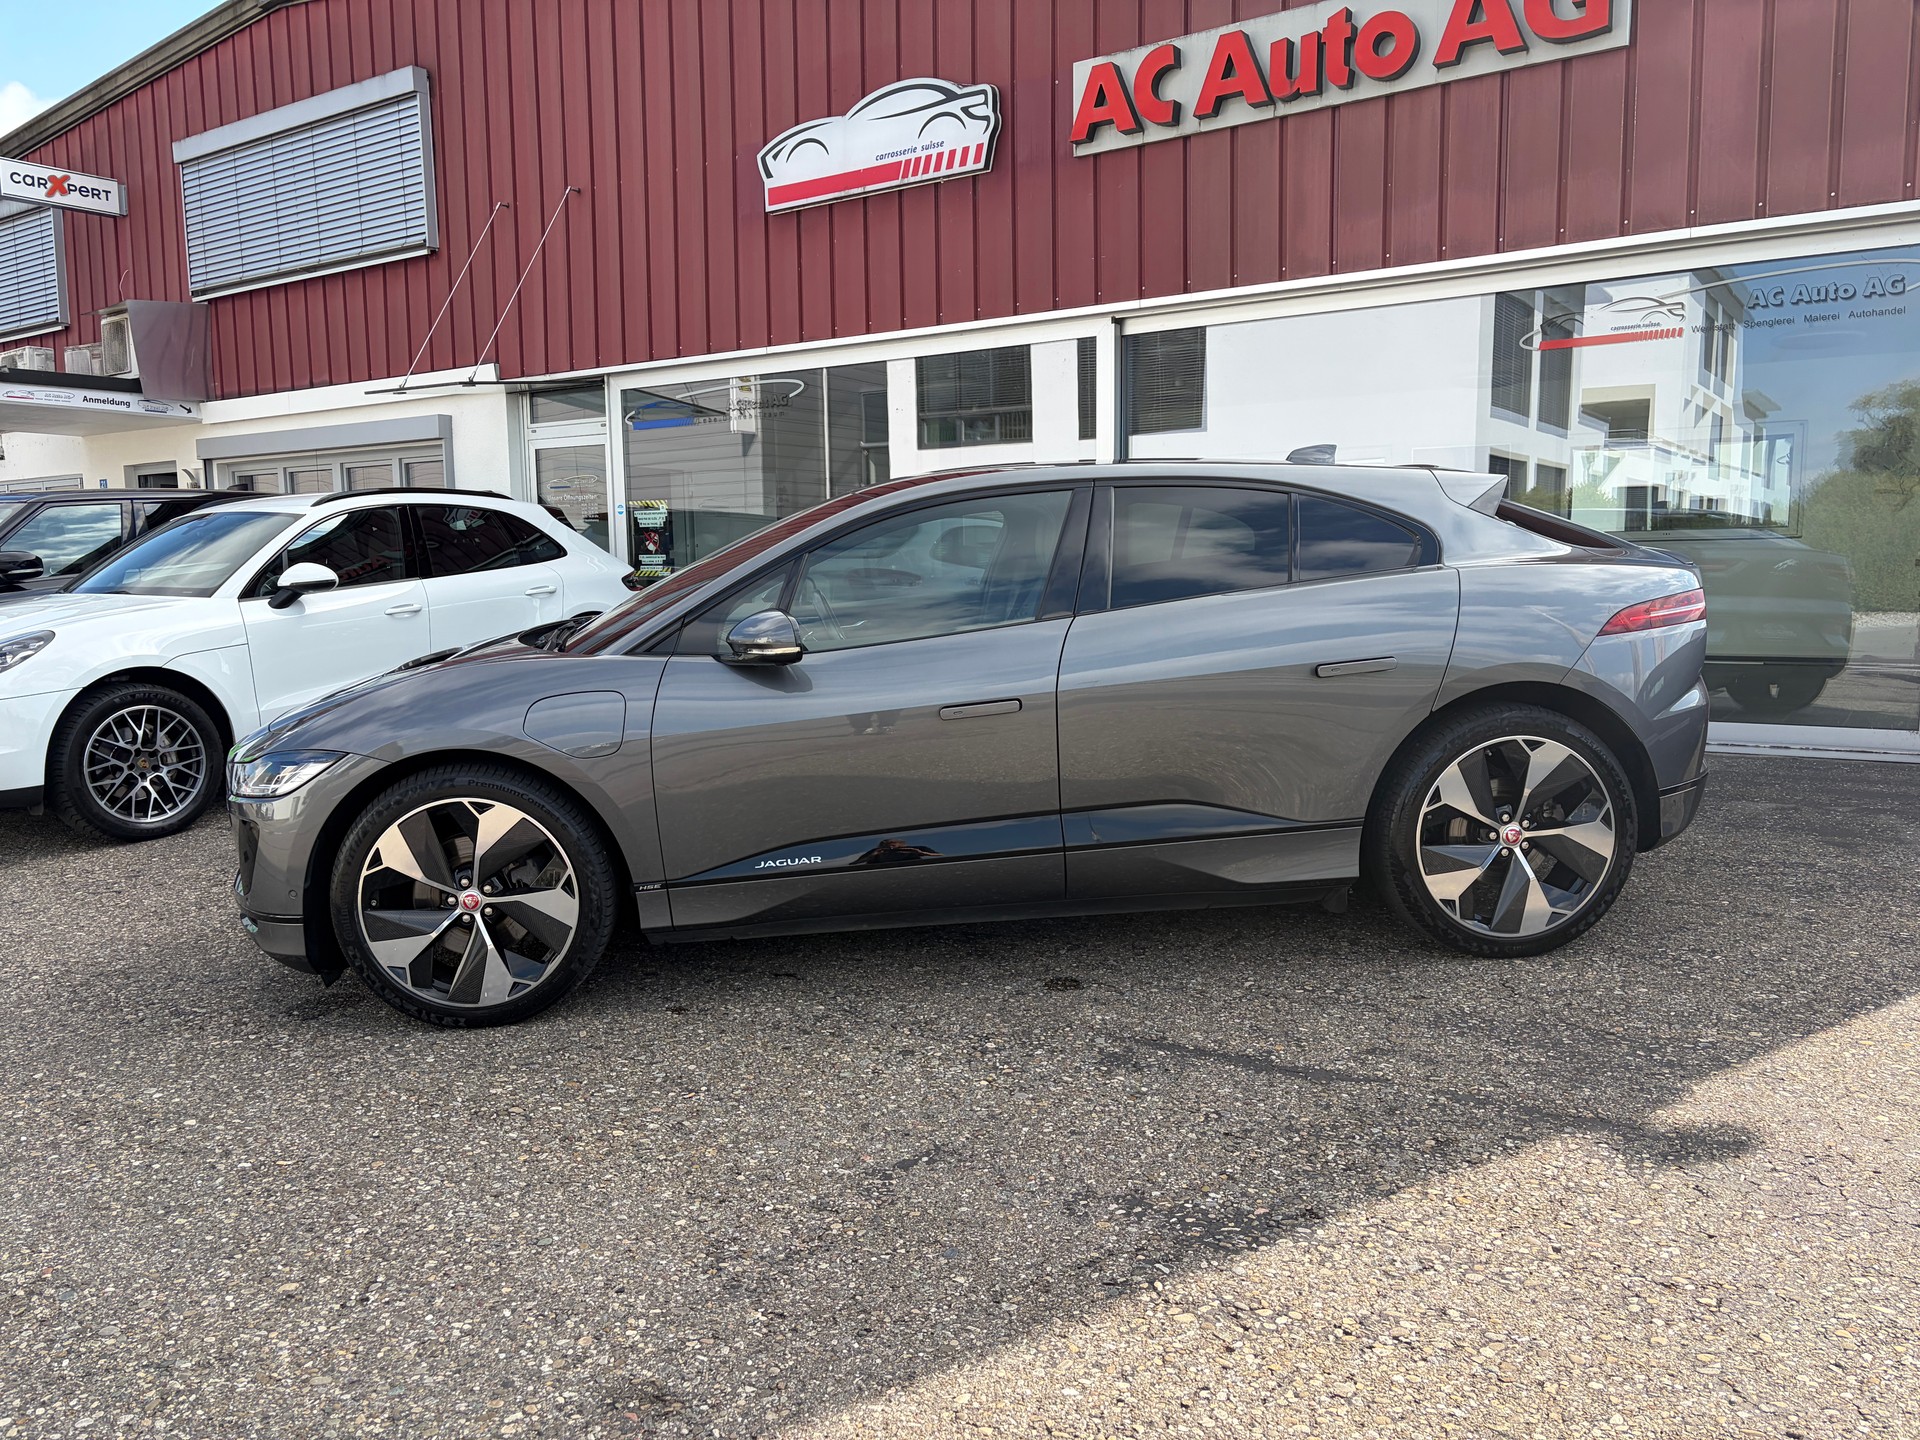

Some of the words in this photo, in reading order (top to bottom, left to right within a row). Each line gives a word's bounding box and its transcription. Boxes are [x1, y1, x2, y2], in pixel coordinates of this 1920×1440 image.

[1069, 44, 1181, 144] AC
[1193, 6, 1421, 119] Auto
[875, 145, 918, 161] carrosserie
[920, 140, 945, 152] suisse
[1747, 286, 1784, 309] AC
[1790, 281, 1857, 304] Auto
[1862, 273, 1905, 298] AG
[1743, 316, 1795, 329] Spenglerei
[1803, 312, 1840, 323] Malerei
[1848, 306, 1906, 319] Autohandel
[82, 394, 131, 409] Anmeldung
[754, 855, 822, 869] JAGUAR
